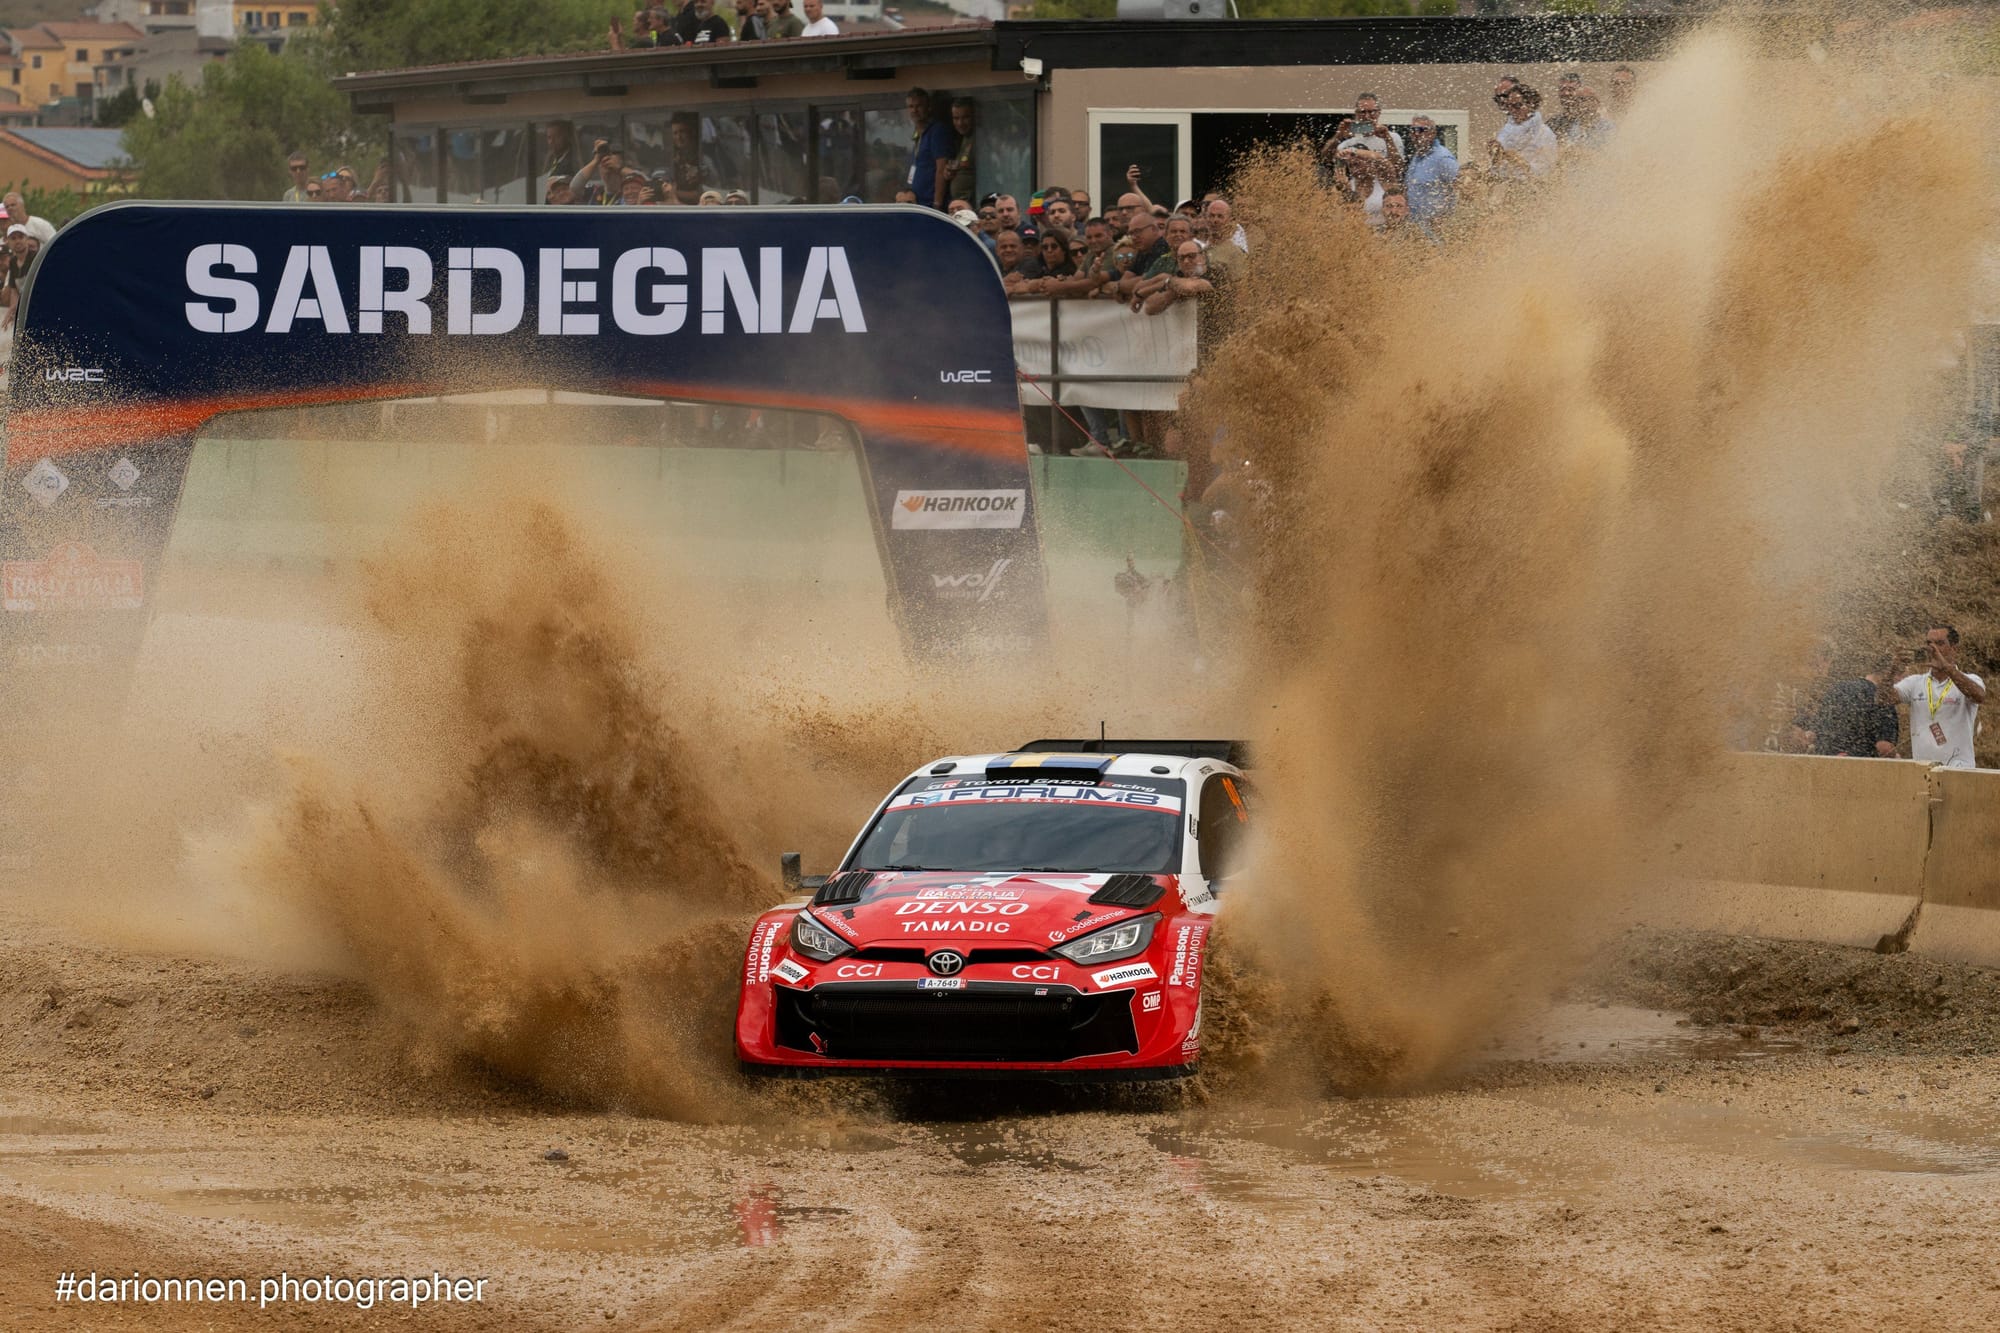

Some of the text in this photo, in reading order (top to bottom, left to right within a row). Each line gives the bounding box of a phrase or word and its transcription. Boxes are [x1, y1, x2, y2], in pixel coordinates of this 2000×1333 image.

[185, 243, 868, 336] SARDEGNA
[45, 367, 104, 382] WRC
[940, 370, 992, 383] WRC
[963, 779, 1029, 787] TOYOTA
[1098, 781, 1157, 792] Racing
[948, 787, 1161, 806] FORUM8
[923, 889, 965, 898] RALLY
[895, 901, 1030, 916] DENSO
[901, 921, 1010, 934] TAMADIC
[746, 921, 768, 985] AUTOMOTIVE
[758, 922, 784, 983] Panasonic
[1169, 925, 1191, 986] Panasonic
[1185, 925, 1205, 989] AUTOMOTIVE
[927, 980, 958, 988] A-7649
[1142, 994, 1161, 1009] OMP
